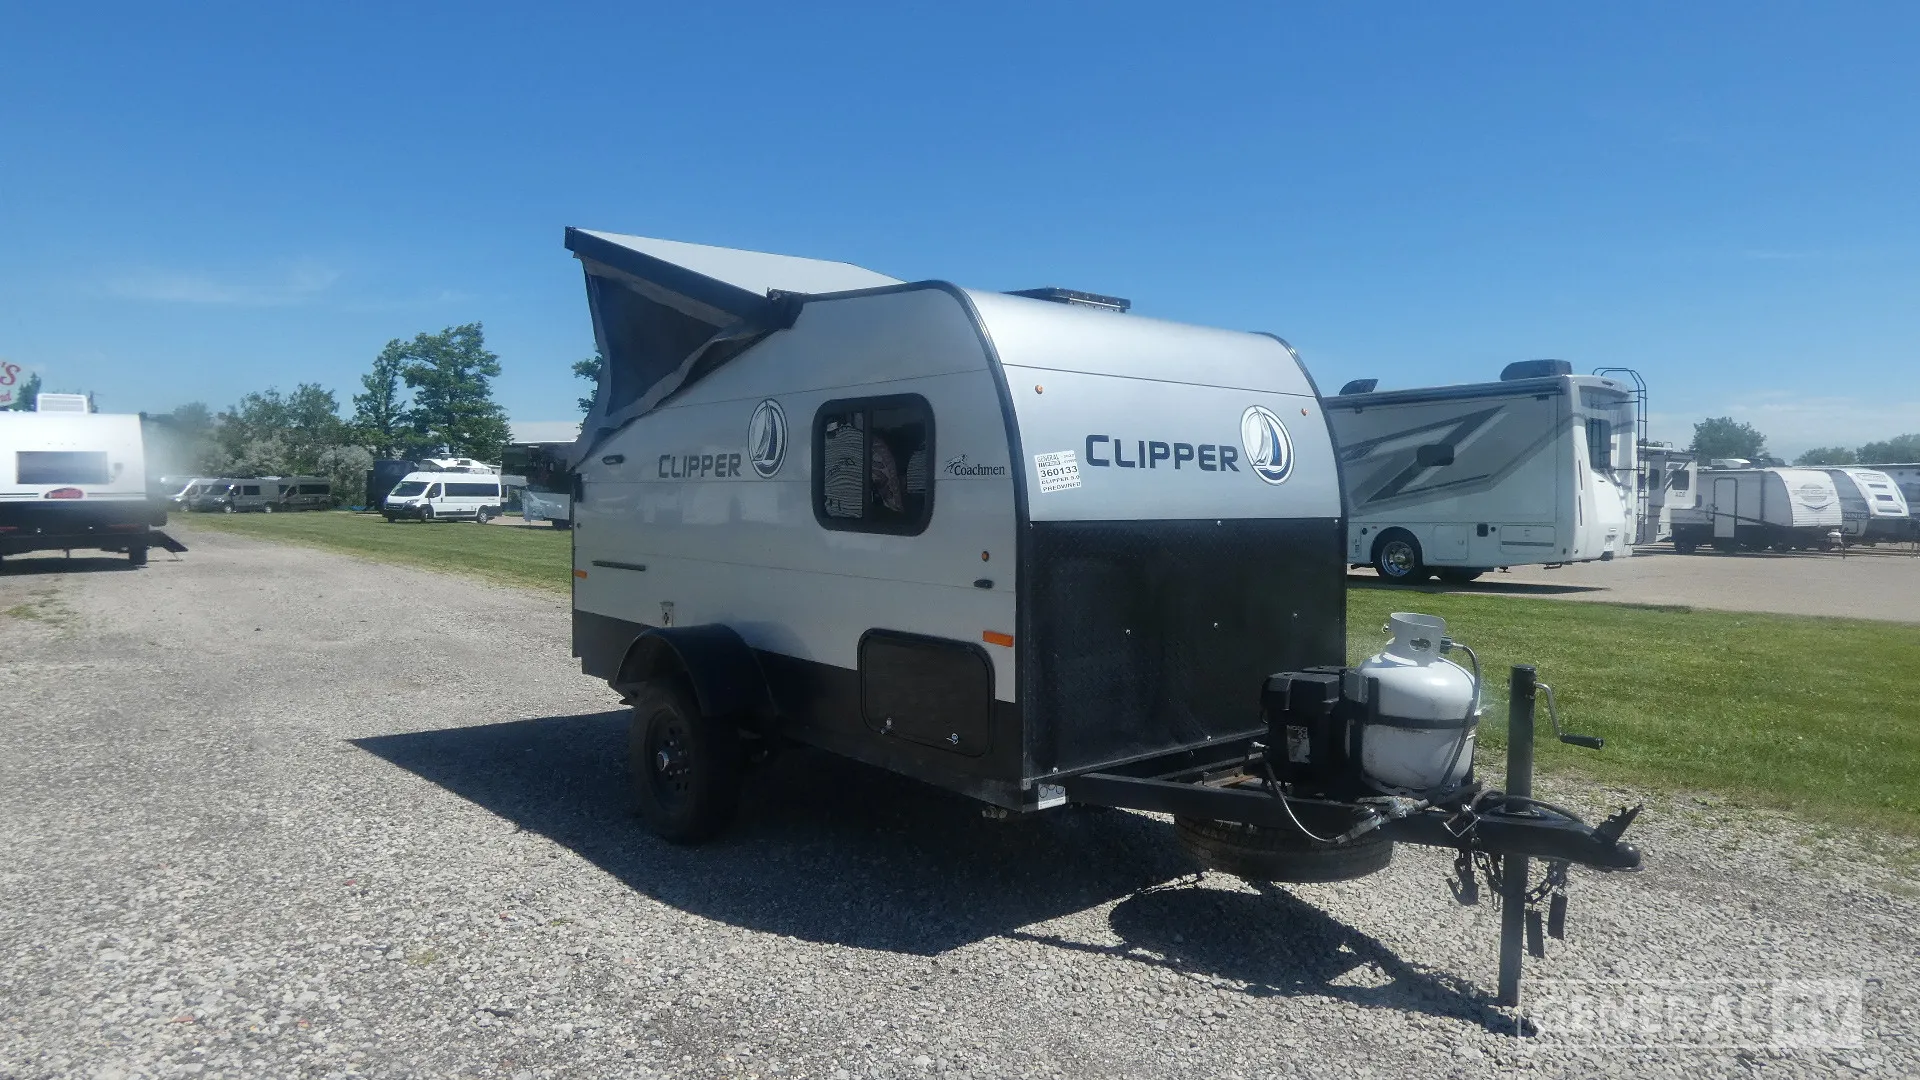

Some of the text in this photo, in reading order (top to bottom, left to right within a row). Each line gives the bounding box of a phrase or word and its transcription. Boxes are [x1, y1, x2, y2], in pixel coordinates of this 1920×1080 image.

[1086, 434, 1240, 472] CLIPPER
[658, 453, 742, 479] CLIPPER
[954, 464, 1005, 476] Coachmen
[1040, 465, 1078, 478] 360133
